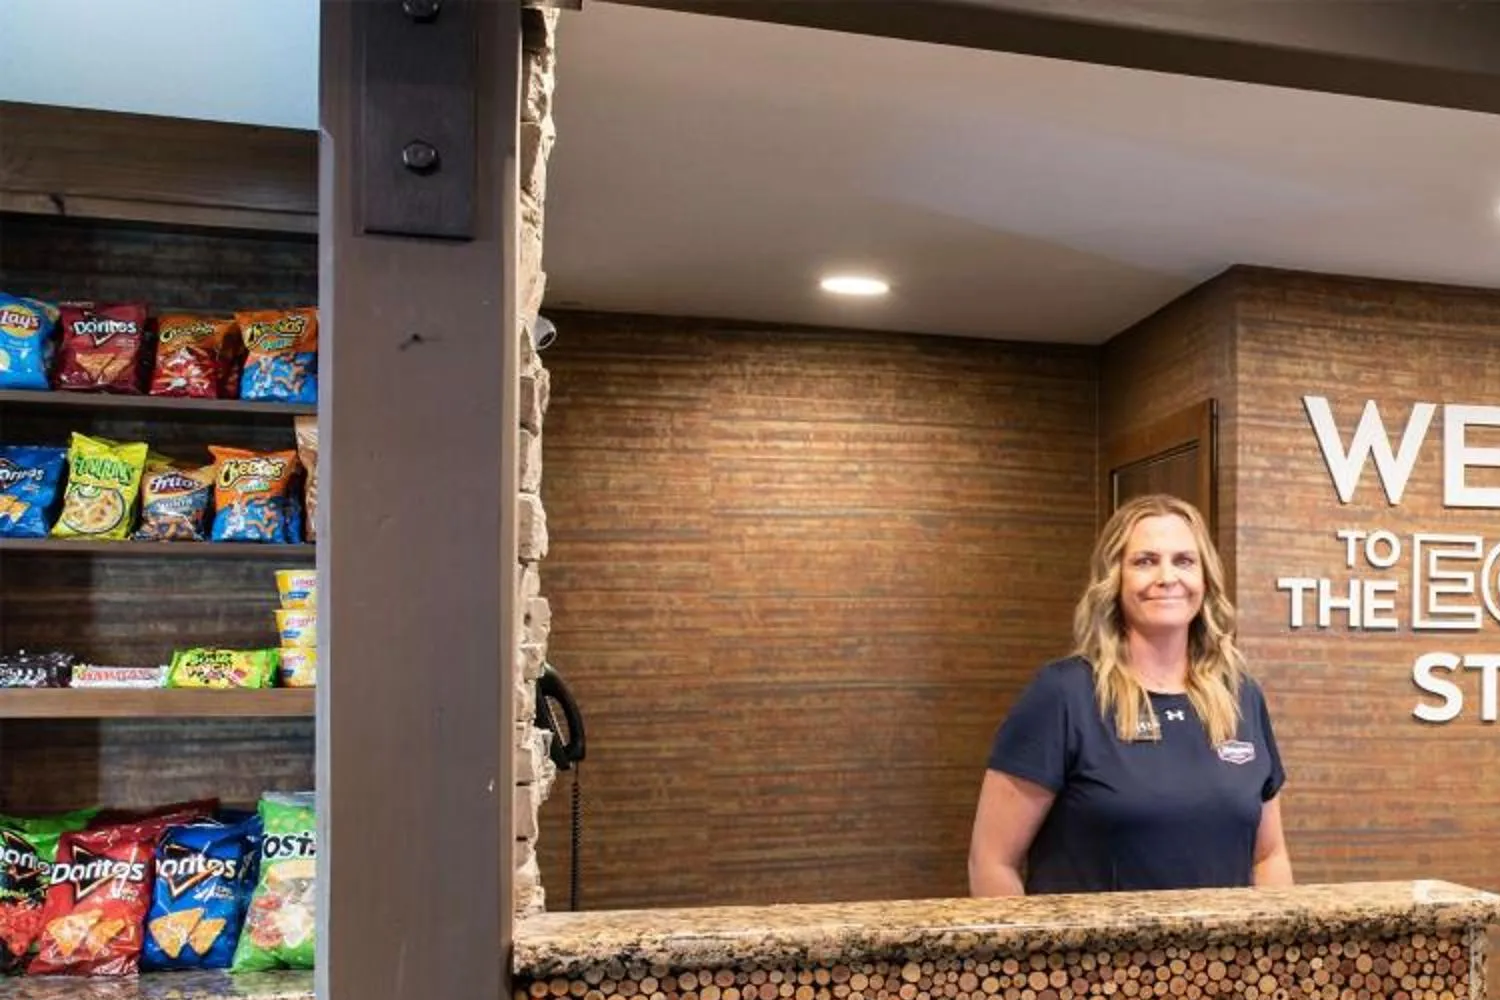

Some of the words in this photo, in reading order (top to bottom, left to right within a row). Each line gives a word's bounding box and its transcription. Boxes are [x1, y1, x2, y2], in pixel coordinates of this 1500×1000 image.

[73, 317, 137, 336] Doritos
[1337, 528, 1401, 569] TO
[1277, 576, 1399, 629] THE
[51, 858, 146, 885] Doritos
[156, 852, 237, 879] oritos
